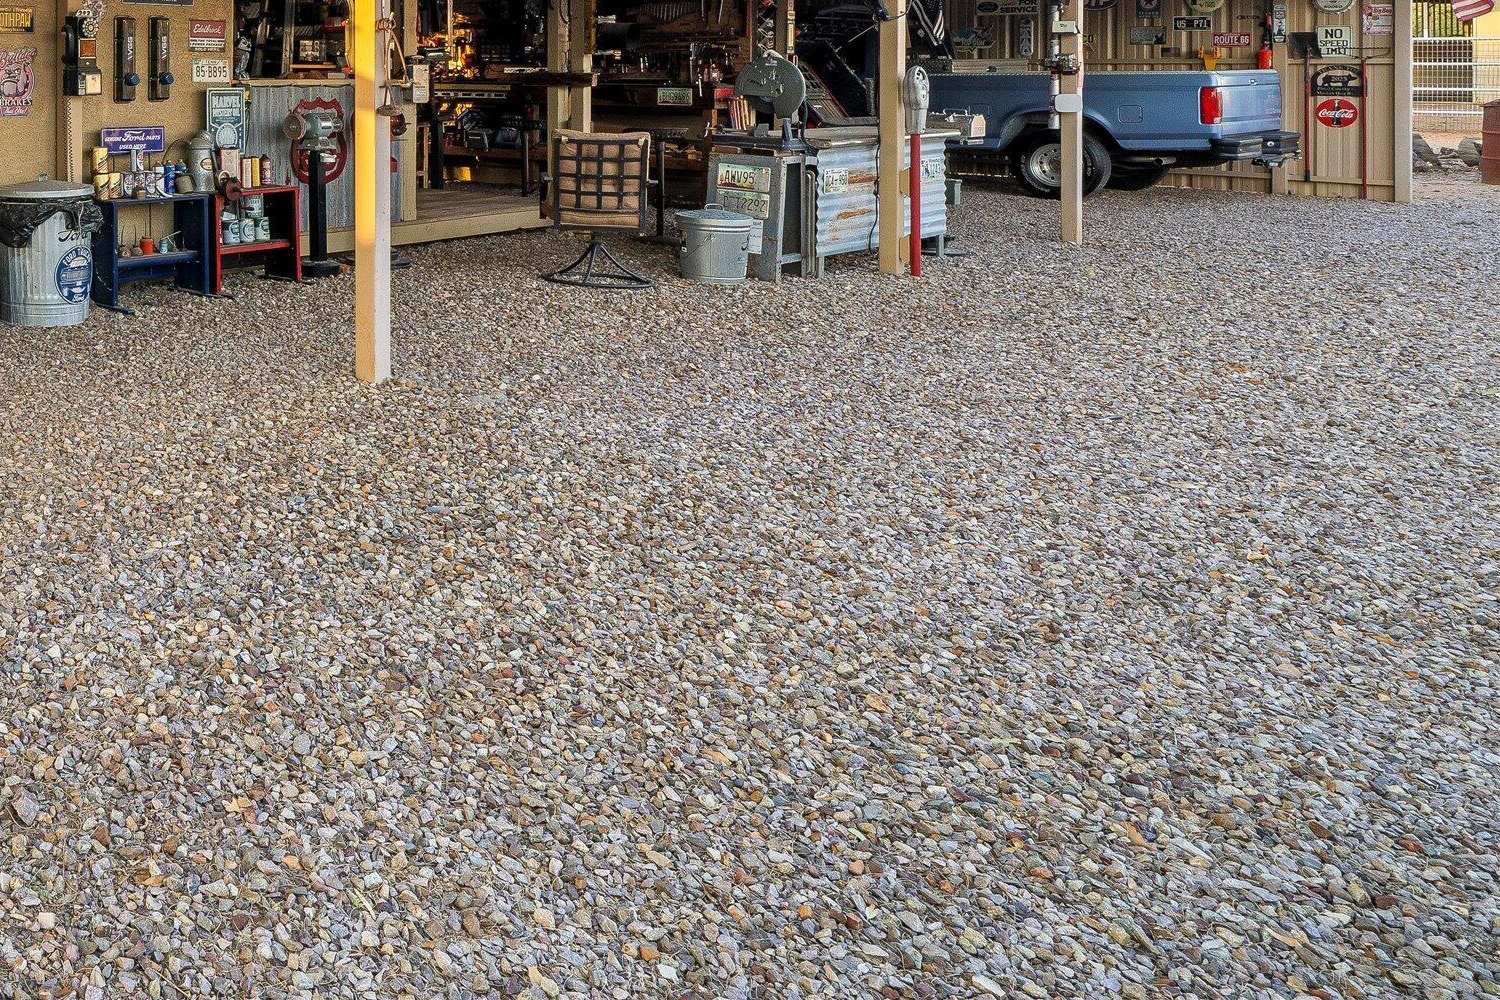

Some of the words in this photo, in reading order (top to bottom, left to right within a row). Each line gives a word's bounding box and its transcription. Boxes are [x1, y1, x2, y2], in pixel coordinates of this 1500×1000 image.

[193, 23, 222, 34] Edelbrock
[1176, 20, 1186, 28] US
[1194, 19, 1208, 28] P71
[1325, 29, 1343, 39] NO
[1214, 35, 1239, 44] ROUTE
[1240, 35, 1250, 44] 66
[1319, 109, 1355, 118] Coca-Cola
[122, 130, 146, 142] Ford
[62, 250, 77, 266] FORD
